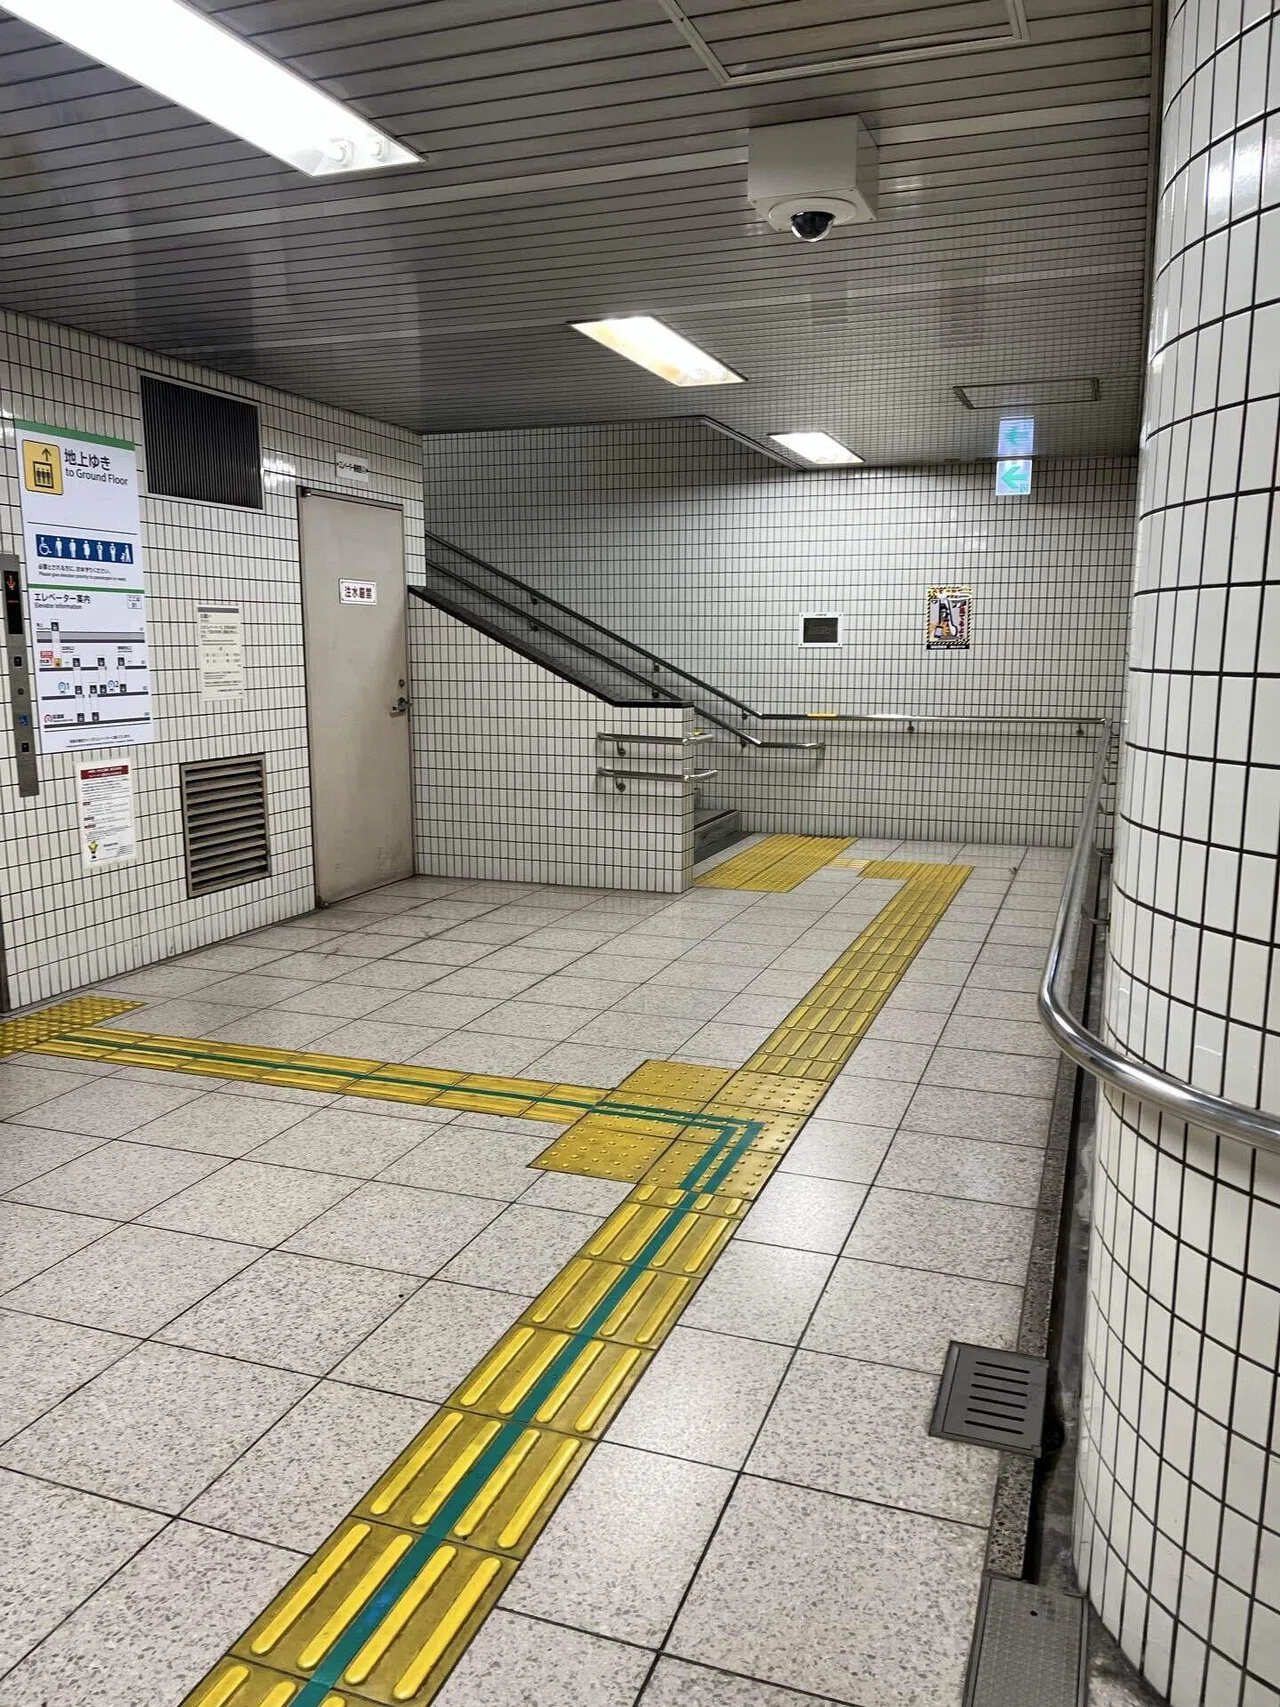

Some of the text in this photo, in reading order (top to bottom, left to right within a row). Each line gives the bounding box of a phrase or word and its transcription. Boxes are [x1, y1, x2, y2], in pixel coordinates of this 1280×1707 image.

[64, 448, 111, 471] 地上ゆき
[65, 468, 128, 486] to Ground Floor
[34, 593, 91, 604] エレベーター案内
